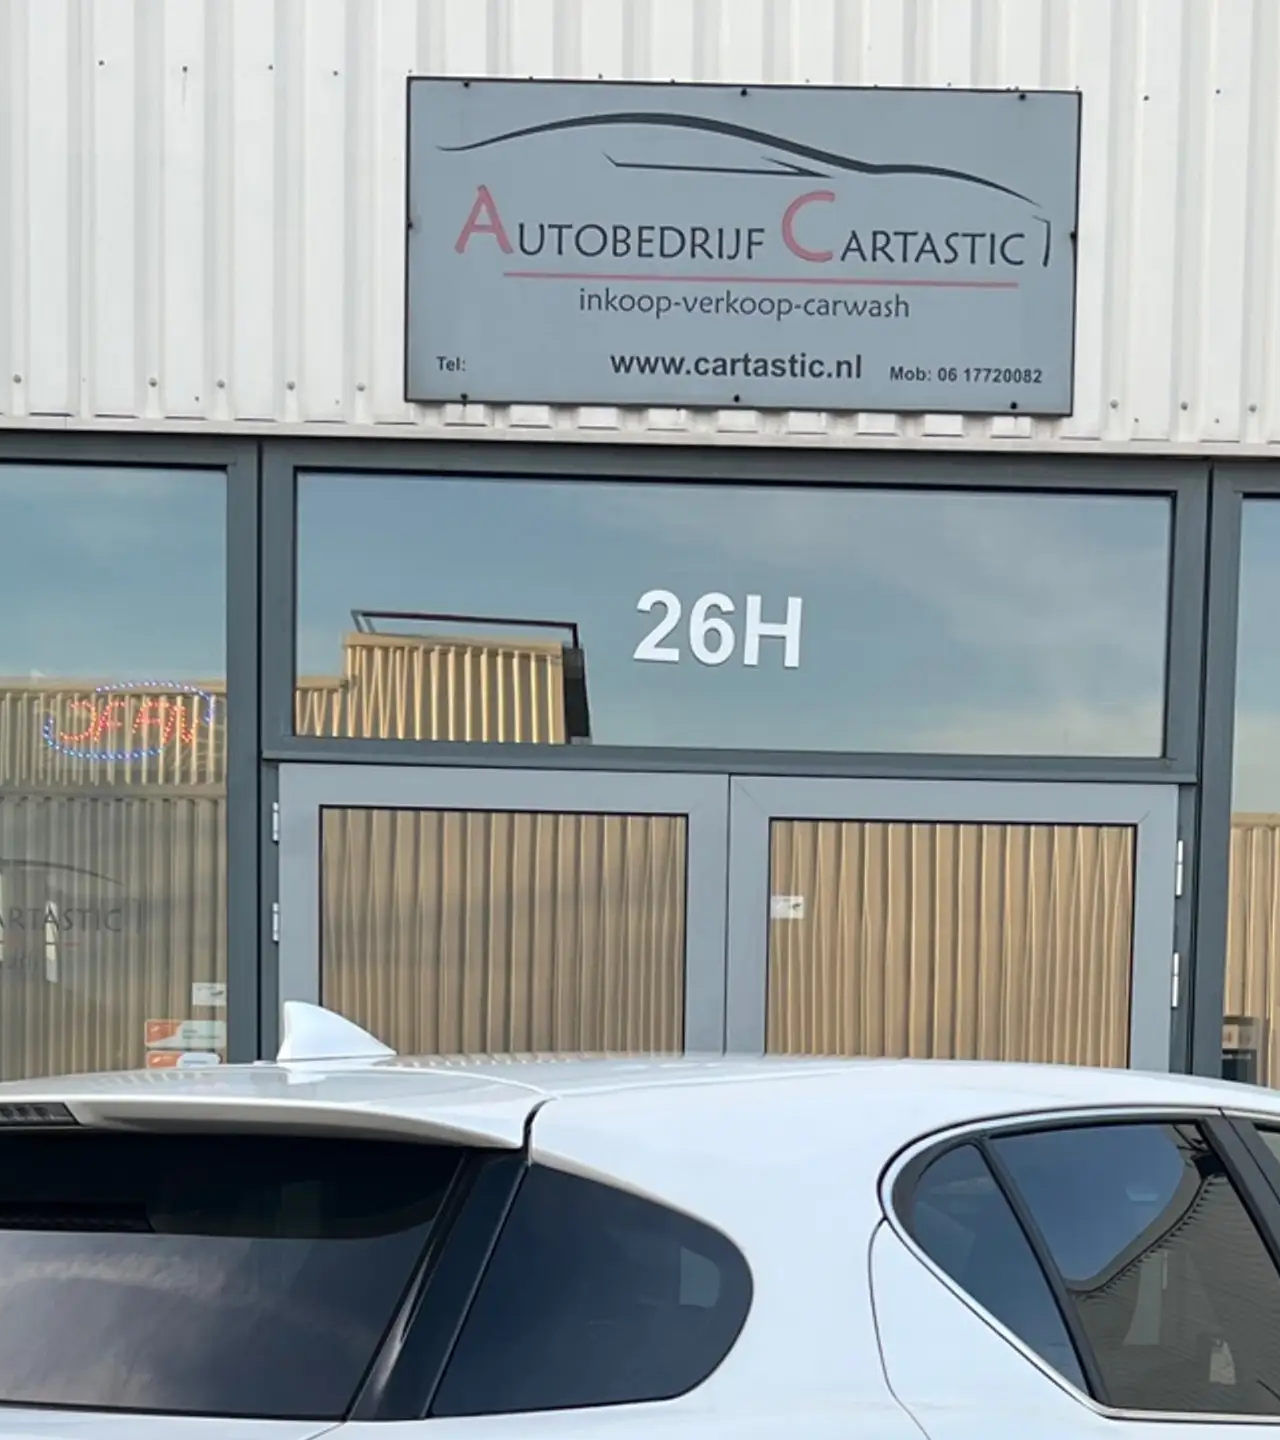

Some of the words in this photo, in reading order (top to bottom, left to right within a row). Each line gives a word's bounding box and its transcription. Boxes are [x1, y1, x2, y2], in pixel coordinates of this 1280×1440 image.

[781, 190, 1025, 266] CARTASTIC
[579, 287, 910, 323] inkoop-verkoop-carwash
[436, 356, 466, 374] Tel:
[610, 340, 864, 382] www.cartastic.nl
[889, 365, 931, 383] Mob:
[937, 367, 958, 384] 06
[964, 367, 1043, 386] 17720082
[632, 589, 803, 669] 26H
